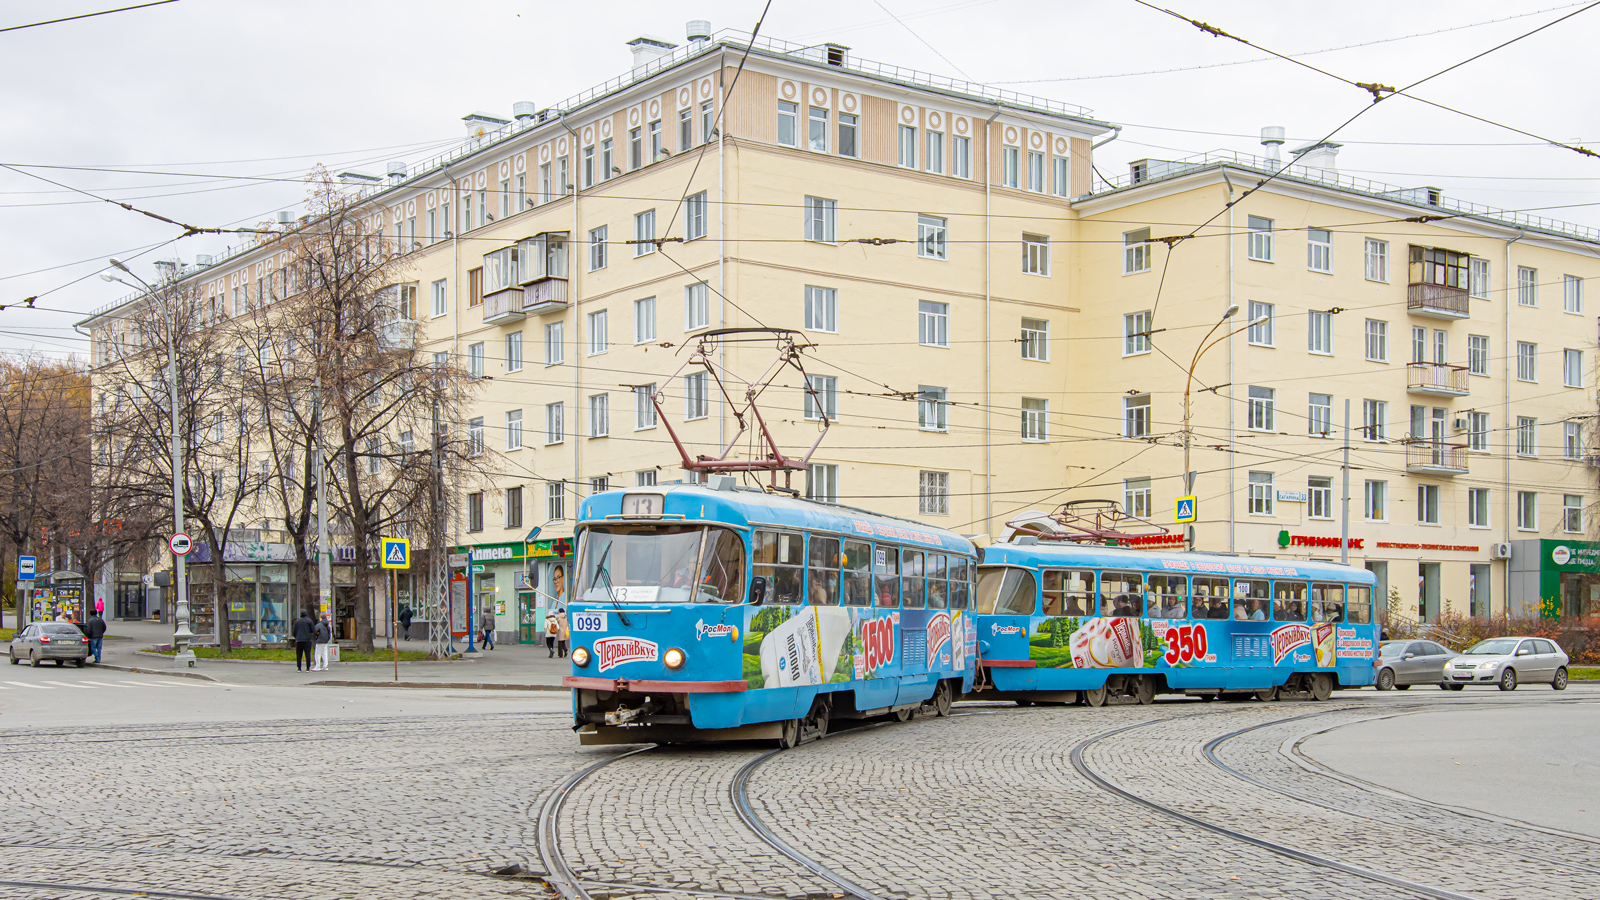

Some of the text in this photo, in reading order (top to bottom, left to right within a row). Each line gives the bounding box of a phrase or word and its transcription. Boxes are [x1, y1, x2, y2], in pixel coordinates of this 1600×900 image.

[632, 498, 652, 518] 13
[469, 547, 513, 560] Аптека
[1239, 585, 1248, 593] 100
[577, 617, 601, 630] 099
[595, 639, 656, 666] ПервыйВкус
[862, 617, 893, 672] 1500
[1165, 625, 1207, 664] 350
